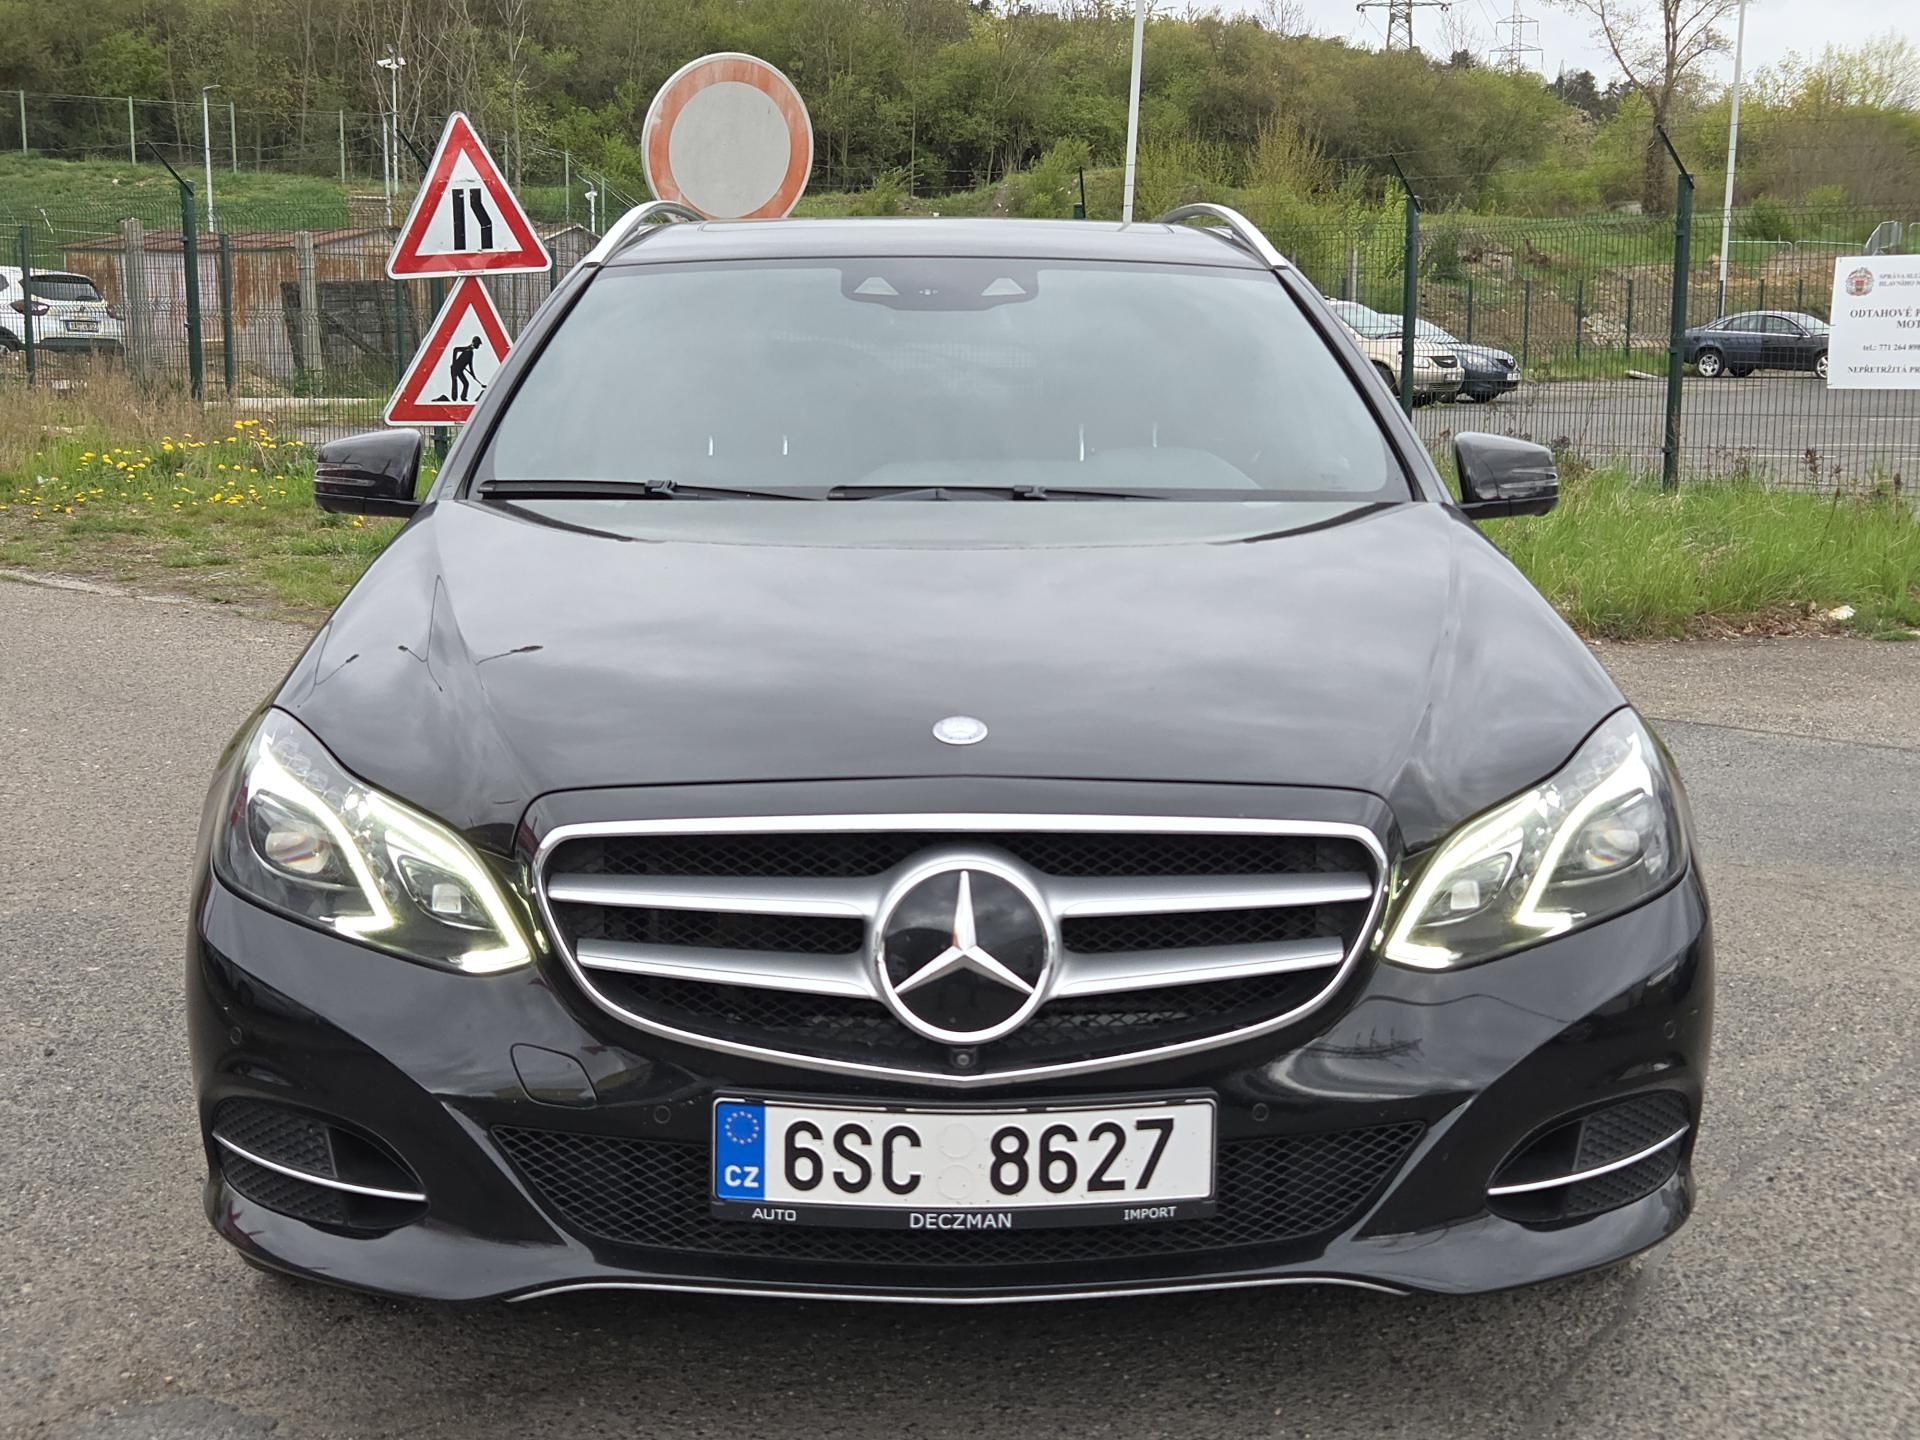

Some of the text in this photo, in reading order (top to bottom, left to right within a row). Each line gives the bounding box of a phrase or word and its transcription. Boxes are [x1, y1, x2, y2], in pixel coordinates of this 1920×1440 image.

[1850, 305, 1912, 318] ODTAHOVÉ
[1879, 343, 1891, 351] 771
[1848, 363, 1907, 374] NEPŘETRŽITÁ
[785, 1118, 1174, 1195] 6SC 8627
[725, 1165, 759, 1188] CZ
[752, 1206, 1177, 1229] AUTO DECZMAN IMPORT
